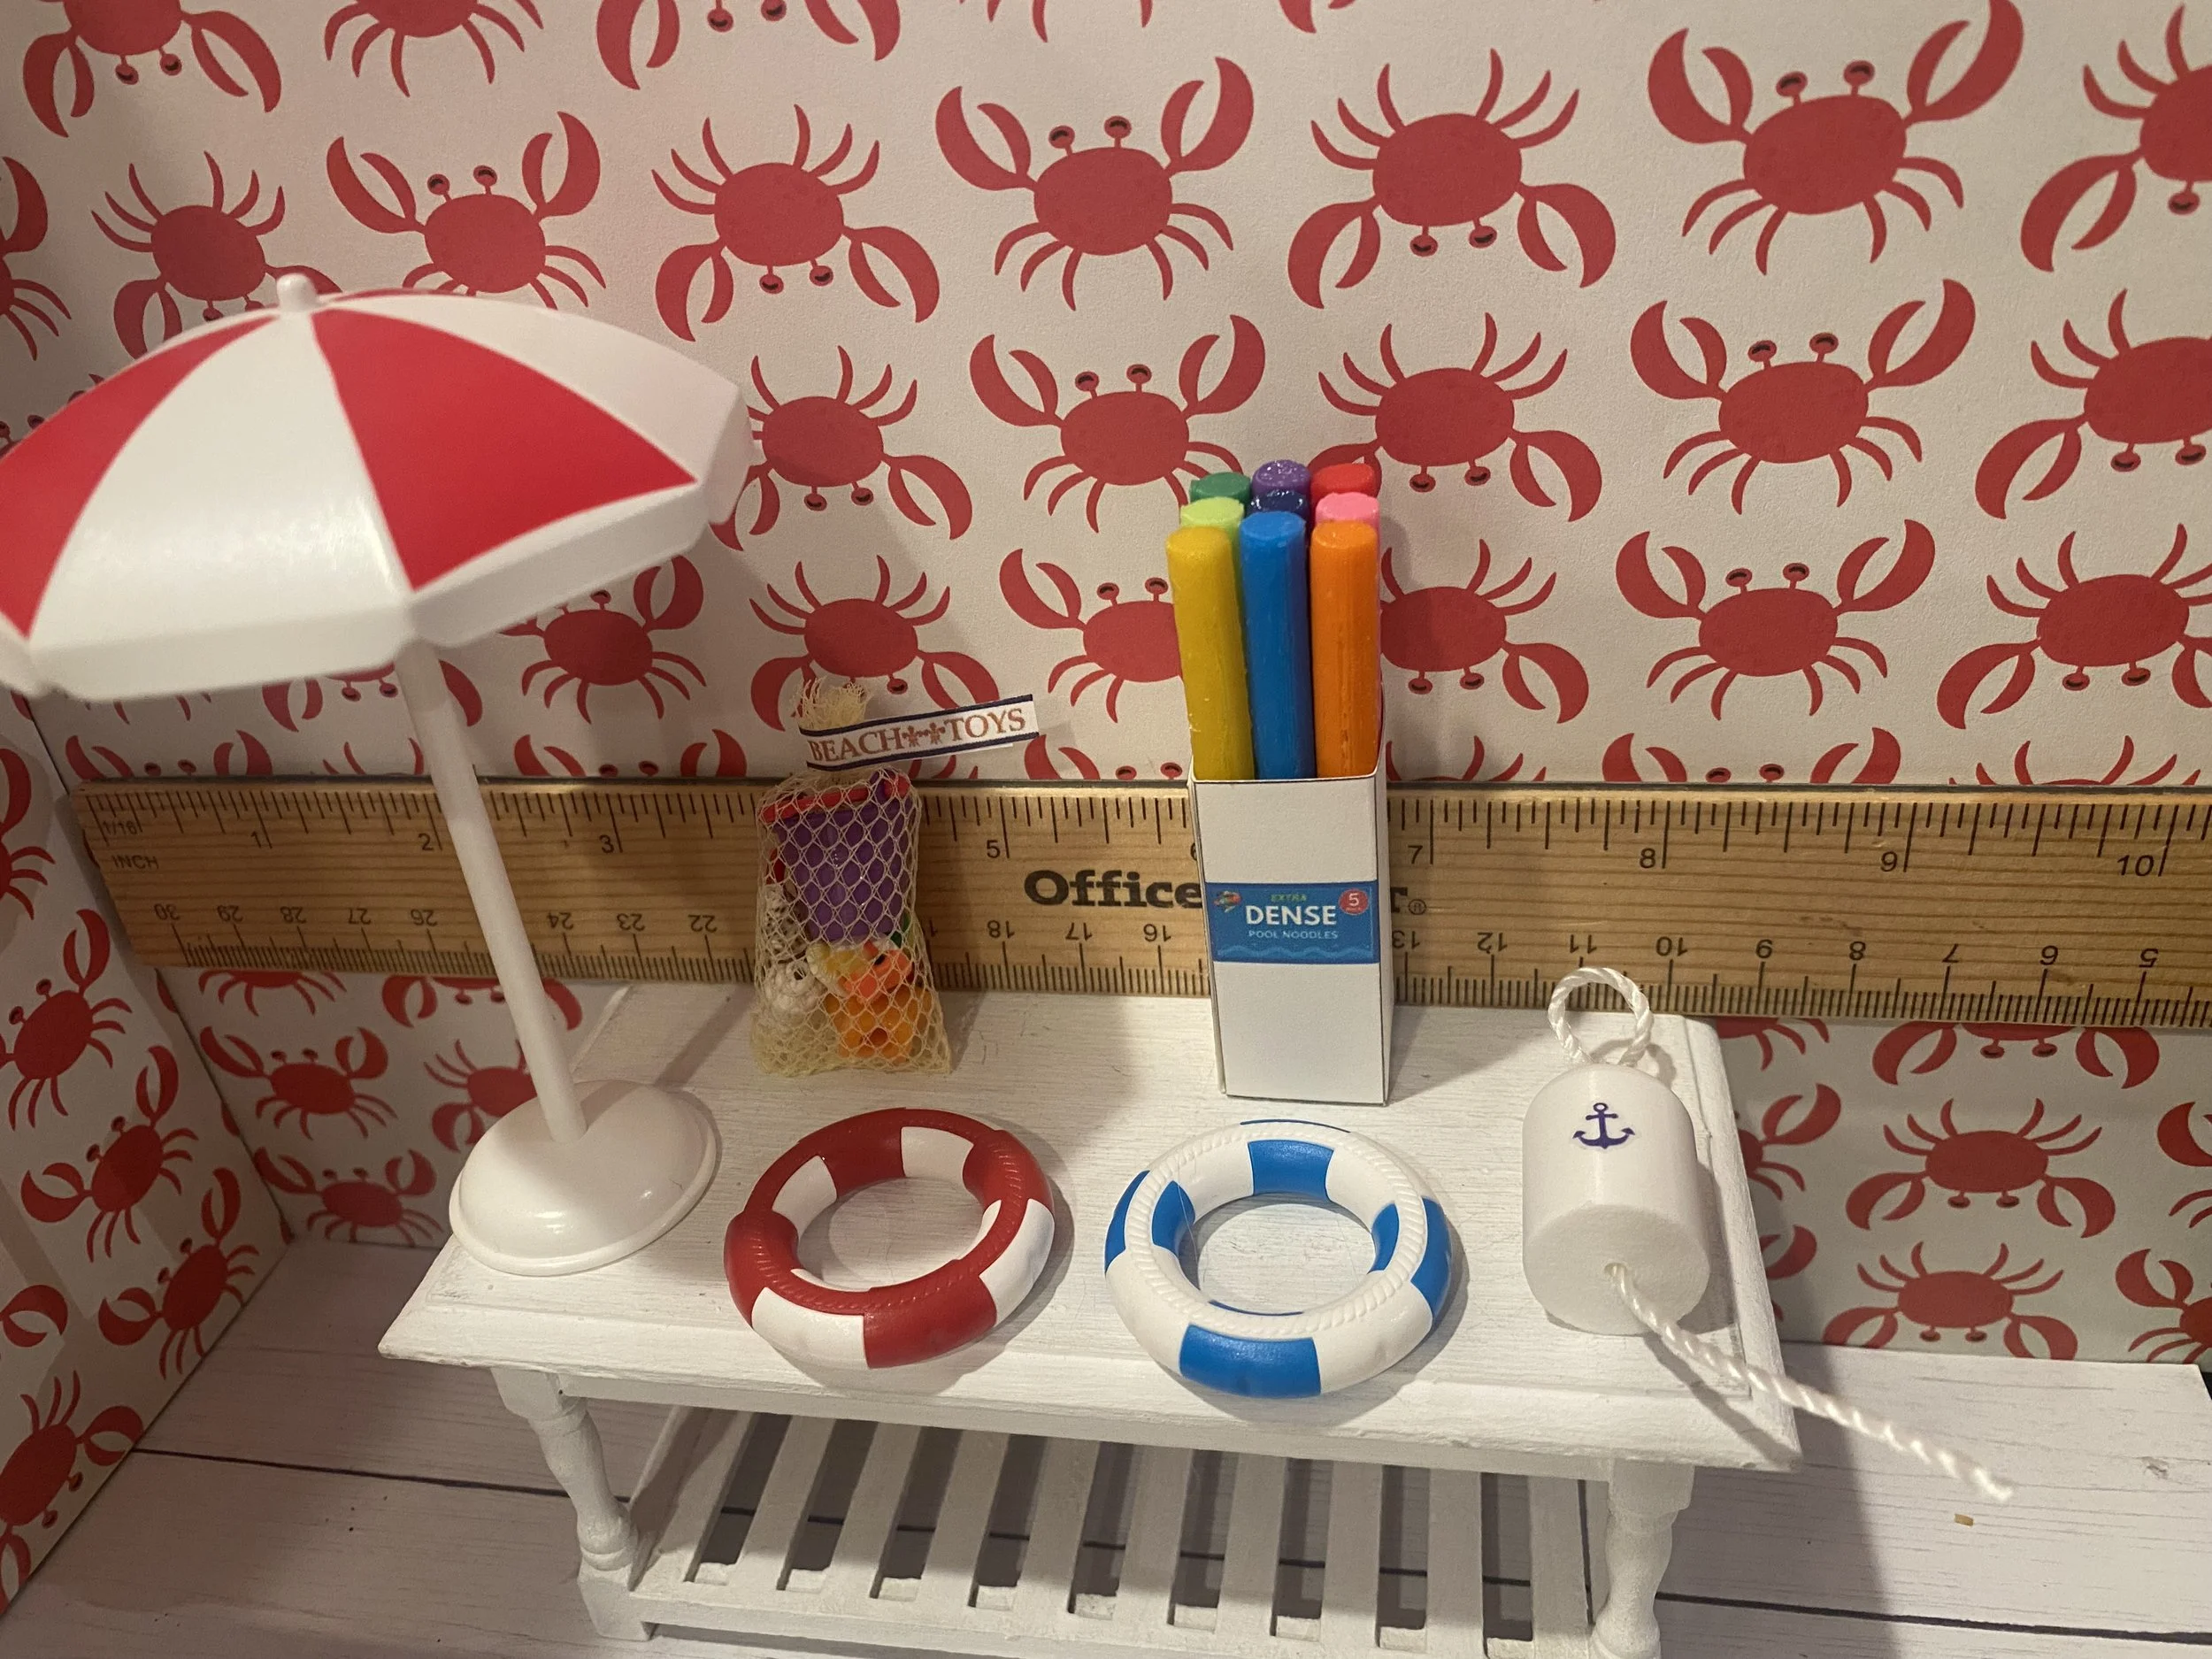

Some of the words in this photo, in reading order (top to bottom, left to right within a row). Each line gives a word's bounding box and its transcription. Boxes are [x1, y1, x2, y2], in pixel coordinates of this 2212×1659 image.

[807, 726, 904, 762] BEACH
[944, 708, 1026, 741] TOYS
[111, 855, 159, 870] INCH
[251, 830, 262, 849] 1
[418, 833, 434, 851] 2
[599, 834, 615, 854] 3
[986, 840, 1001, 859] 5
[1408, 844, 1424, 864] 7
[1639, 848, 1656, 869] 8
[1880, 850, 1899, 872] 9
[2116, 854, 2154, 877] 10
[1024, 870, 1202, 909] Office
[1348, 893, 1359, 906] 5
[154, 903, 180, 920] 30
[217, 905, 244, 923] 29
[280, 906, 307, 924] 28
[347, 908, 372, 926] 27
[411, 909, 438, 926] 26
[547, 911, 574, 930] 24
[1245, 905, 1337, 926] DENSE
[616, 913, 645, 932] 23
[688, 914, 718, 933] 22
[987, 919, 1015, 939] 18
[1064, 922, 1093, 941] 17
[1143, 923, 1171, 942] 16
[1248, 930, 1278, 939] POOL
[1282, 930, 1339, 939] NOODLES
[1391, 930, 1421, 949] 13
[1477, 932, 1508, 952] 12
[1569, 934, 1598, 953] 11
[1655, 936, 1688, 956] 10
[1755, 938, 1774, 958] 9
[1848, 941, 1866, 961] 8
[1942, 943, 1960, 964] 7
[2039, 945, 2059, 965] 6
[2139, 947, 2159, 968] 5
